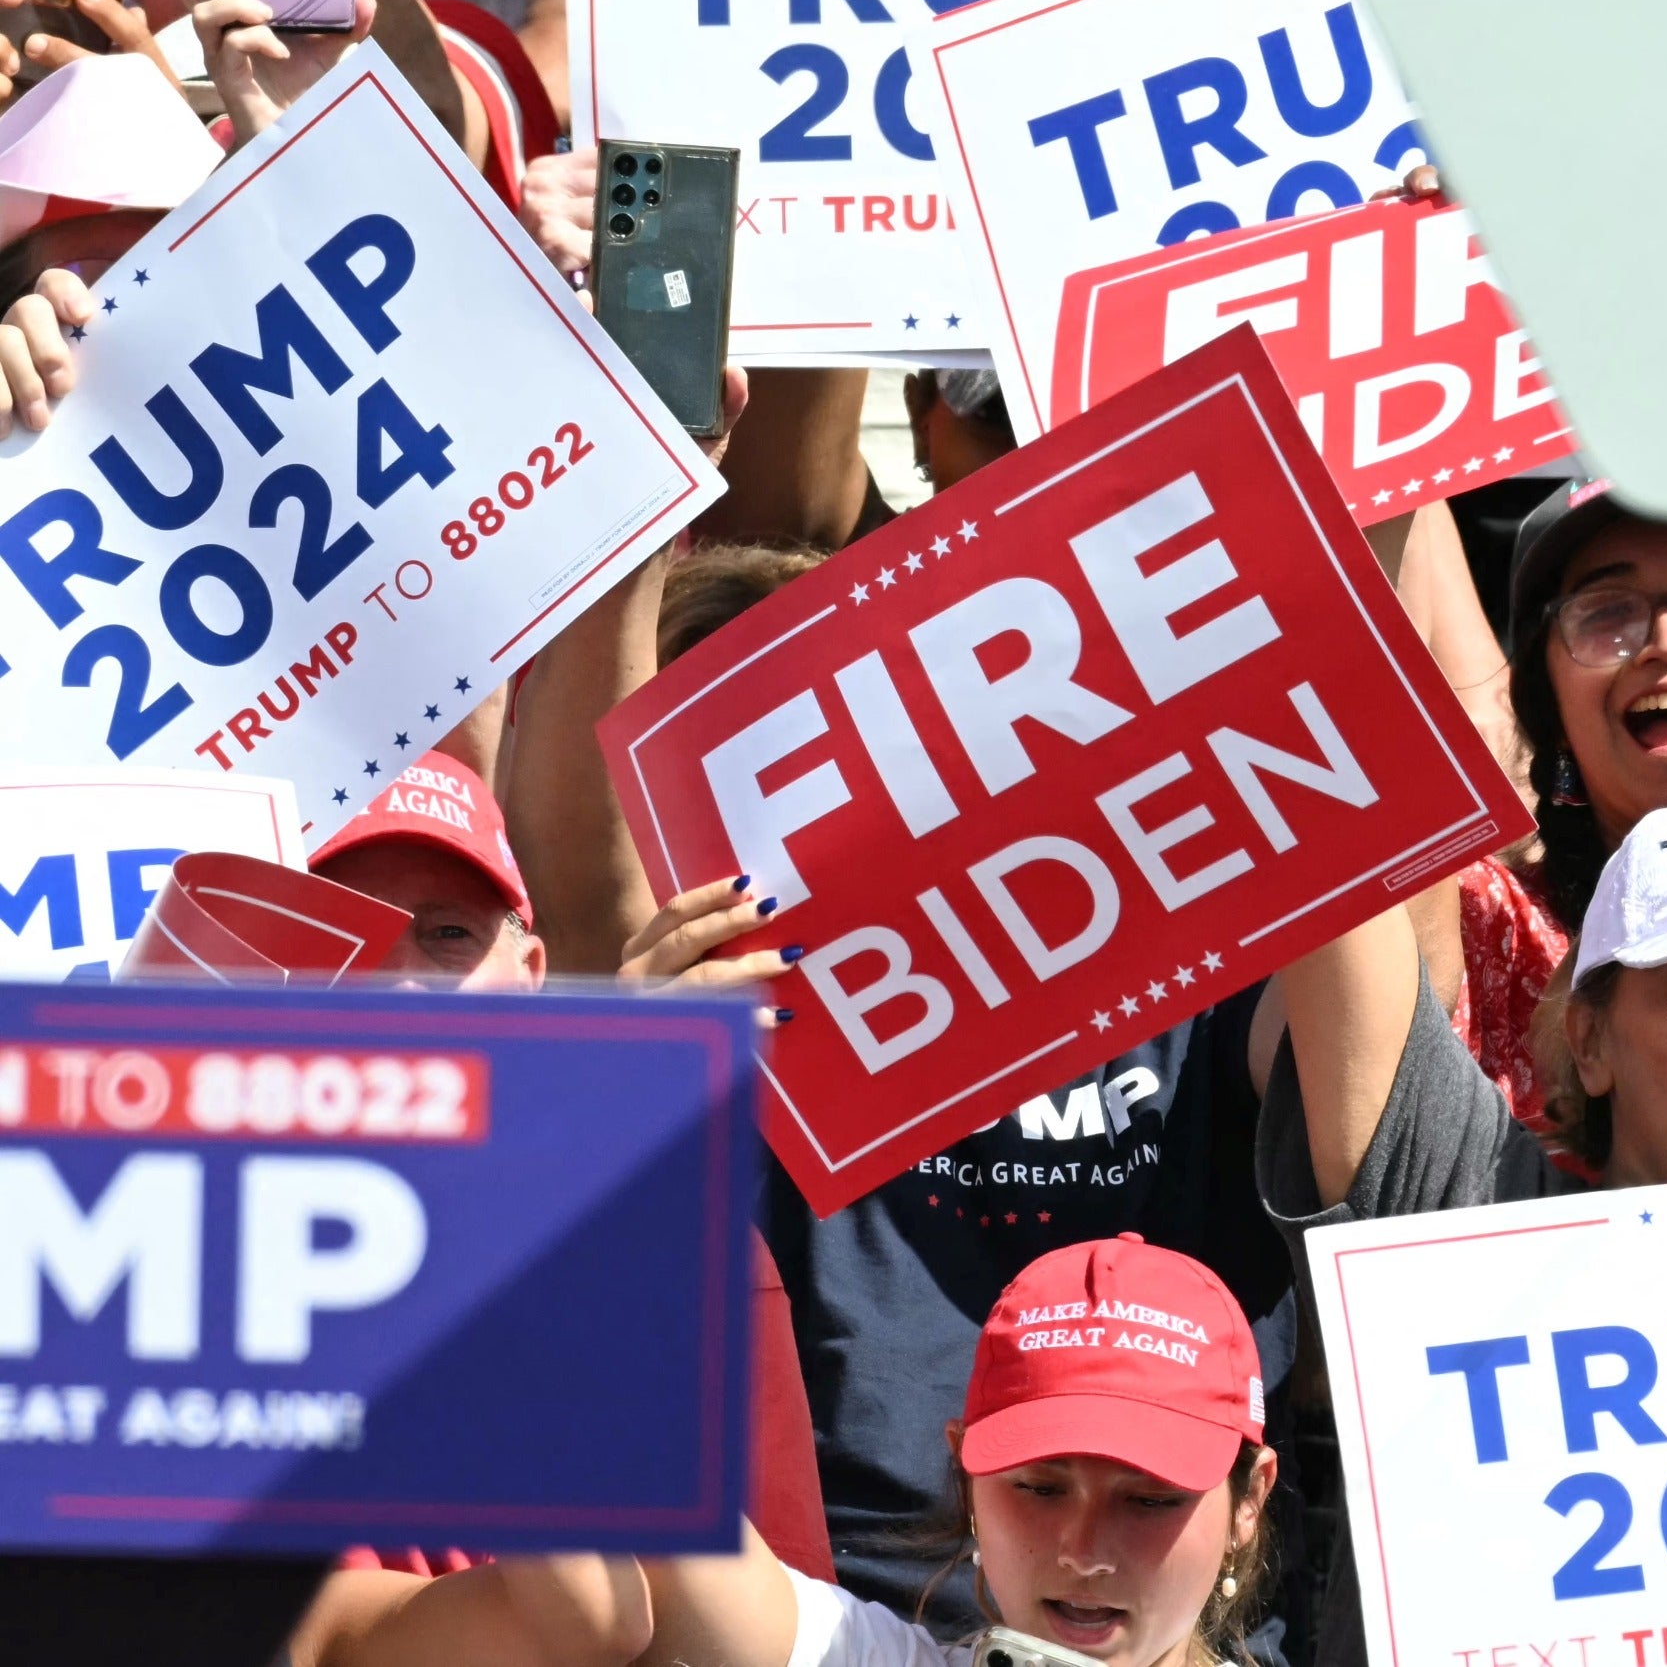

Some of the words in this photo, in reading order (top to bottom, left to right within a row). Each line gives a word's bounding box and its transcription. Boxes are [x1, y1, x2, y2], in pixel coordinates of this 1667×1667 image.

[1027, 1, 1375, 222] TRU
[0, 213, 417, 632] RUMP
[61, 377, 457, 761] 2024
[194, 621, 359, 772] TRUMP
[364, 560, 433, 622] TO
[440, 421, 596, 561] 88022
[701, 471, 1283, 915] FIRE
[386, 786, 473, 834] AGAIN
[395, 766, 477, 812] ERICA
[798, 680, 1382, 1077] BIDEN
[40, 1050, 171, 1131] TO
[185, 1048, 469, 1137] 88022
[991, 1161, 1082, 1186] GREAT
[1013, 1301, 1087, 1328] MAKE
[1091, 1298, 1211, 1345] AMERICA
[1017, 1327, 1106, 1352] GREAT
[1112, 1330, 1199, 1368] AGAIN
